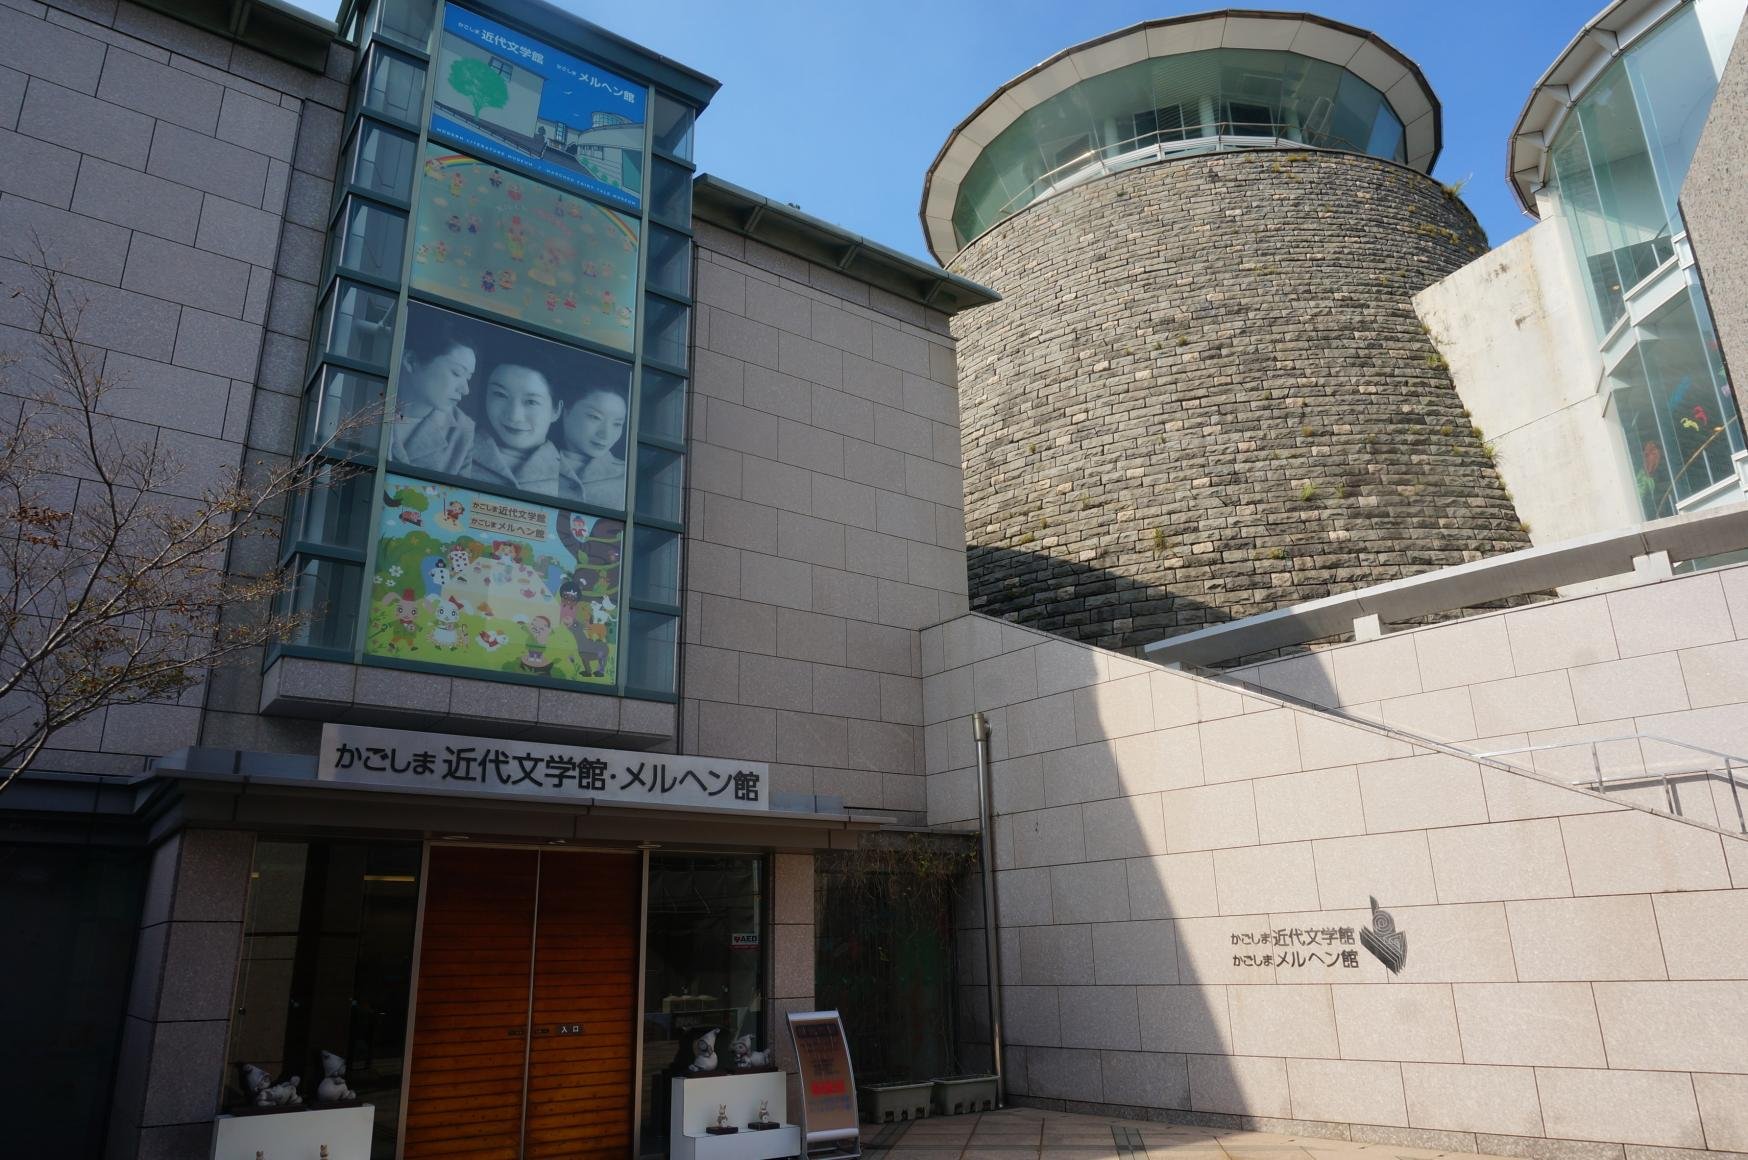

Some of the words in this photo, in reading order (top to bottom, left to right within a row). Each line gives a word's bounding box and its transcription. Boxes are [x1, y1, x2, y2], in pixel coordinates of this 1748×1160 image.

[1230, 926, 1356, 947] かごしま近代文学館
[1233, 949, 1359, 969] かごしまメルヘン館
